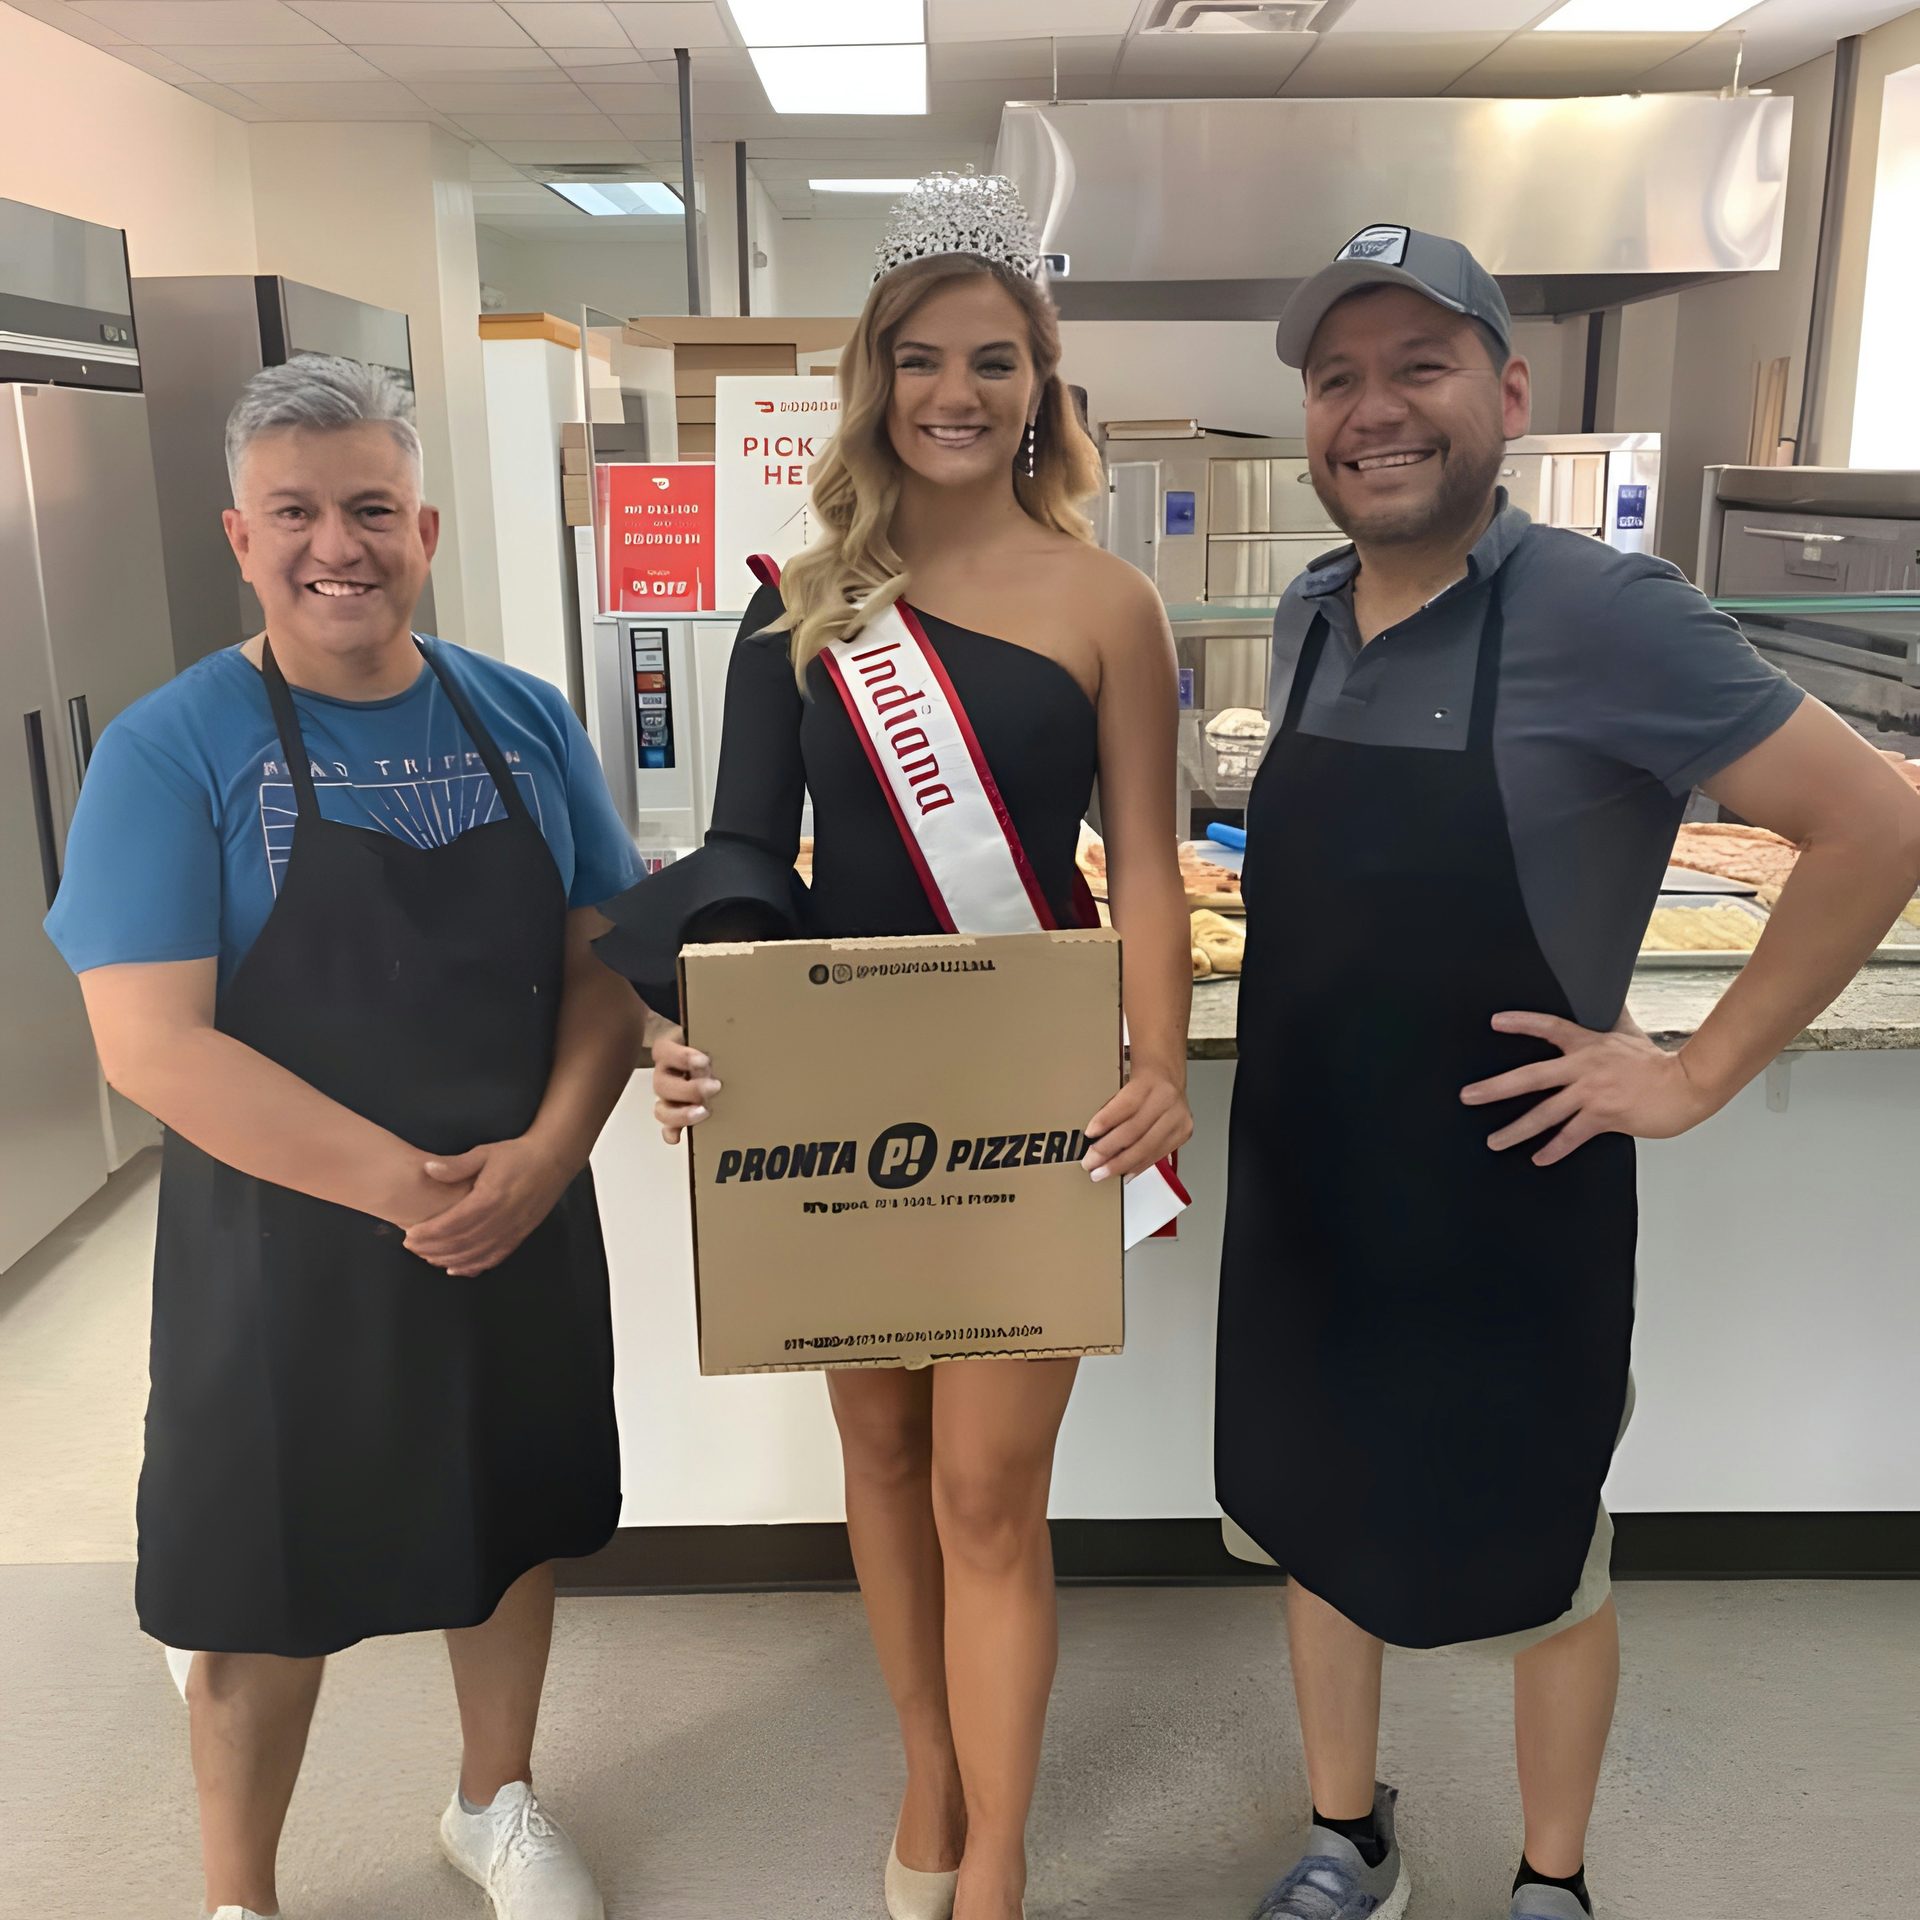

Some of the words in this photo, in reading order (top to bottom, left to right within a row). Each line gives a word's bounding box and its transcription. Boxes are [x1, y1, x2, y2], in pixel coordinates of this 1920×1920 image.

[743, 437, 815, 457] PICK
[764, 465, 803, 485] HE
[850, 642, 955, 816] Indiana
[715, 1140, 858, 1184] PRONTA
